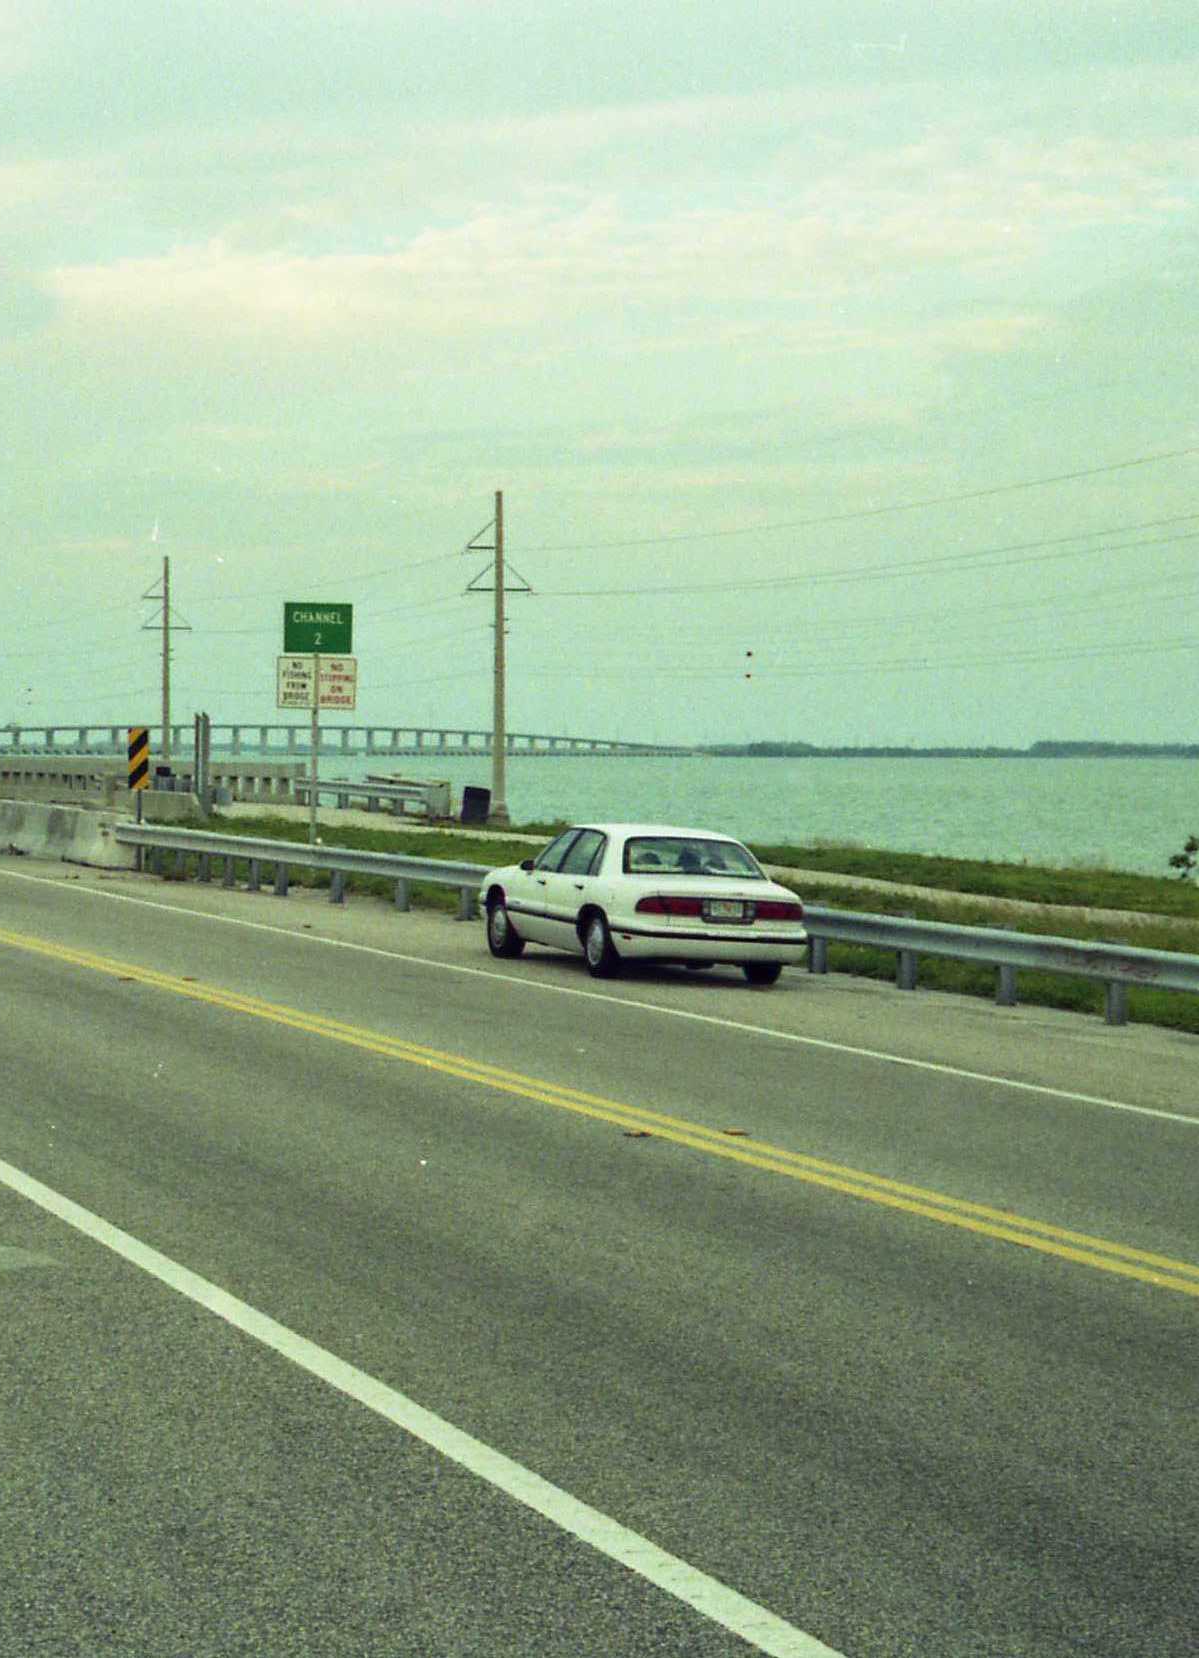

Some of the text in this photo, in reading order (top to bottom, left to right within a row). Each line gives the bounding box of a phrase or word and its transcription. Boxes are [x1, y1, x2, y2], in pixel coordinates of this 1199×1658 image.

[292, 611, 344, 625] CHANNEL
[314, 632, 324, 646] 2
[330, 663, 344, 671] NO
